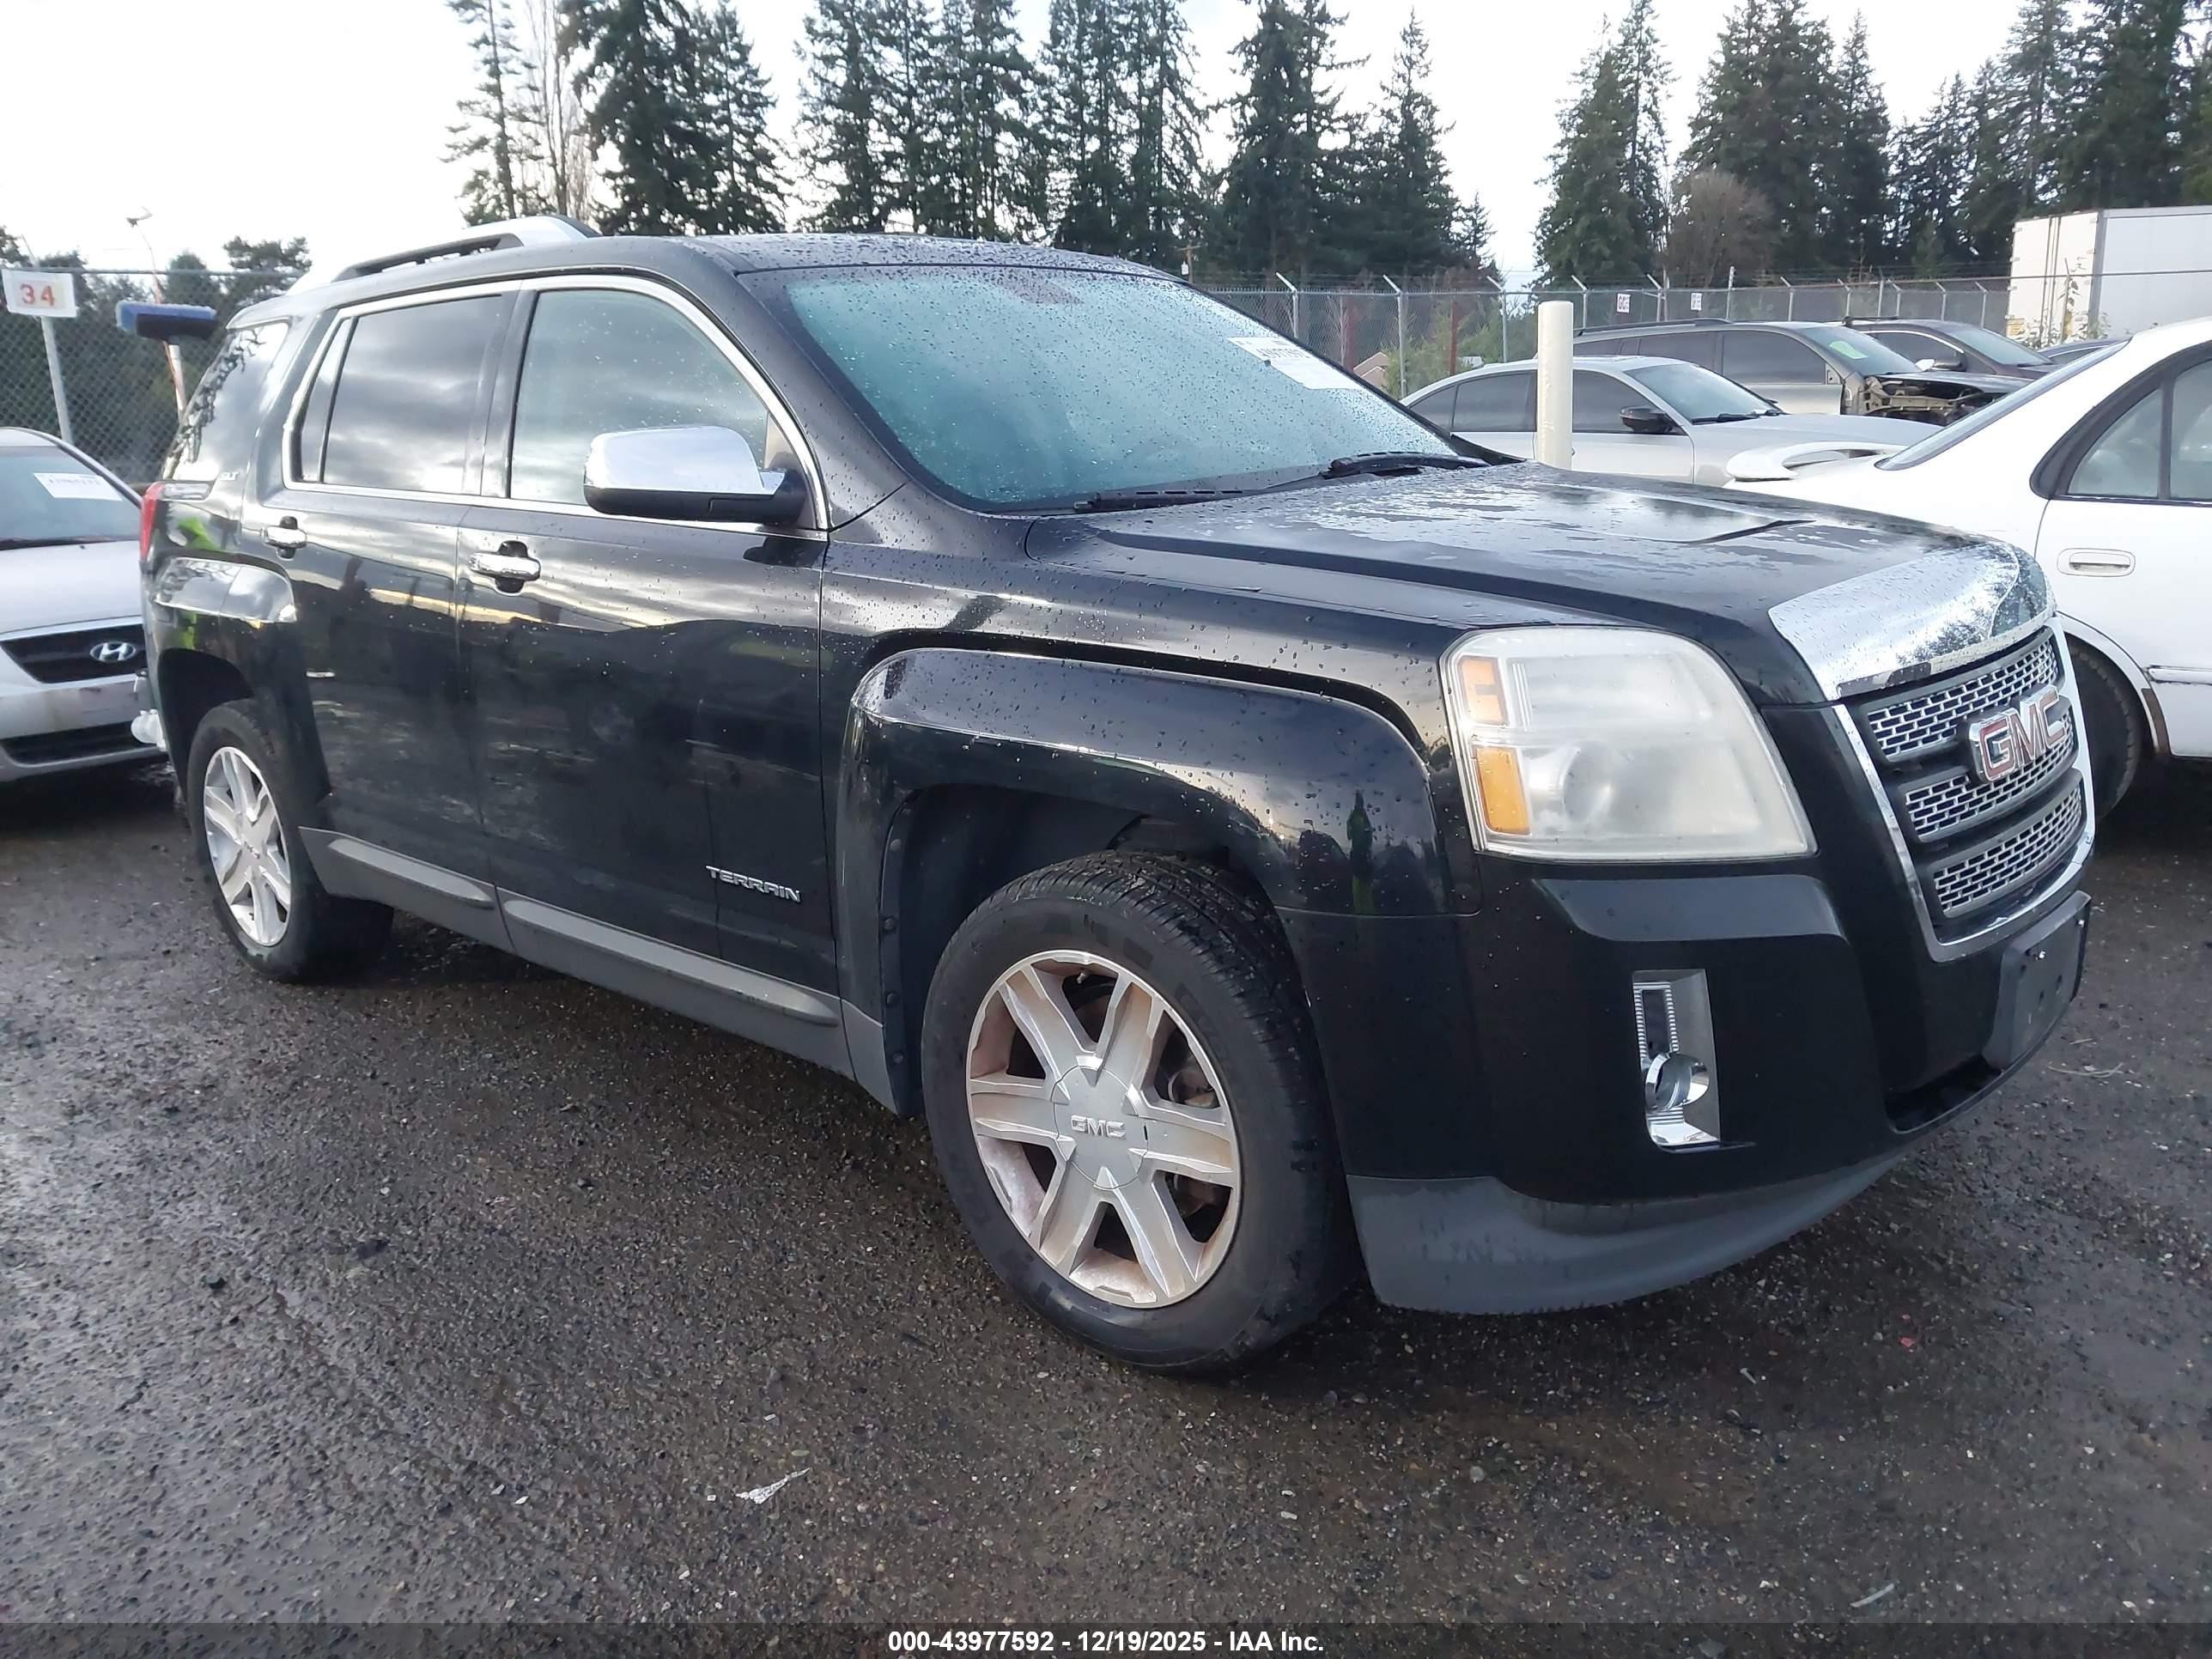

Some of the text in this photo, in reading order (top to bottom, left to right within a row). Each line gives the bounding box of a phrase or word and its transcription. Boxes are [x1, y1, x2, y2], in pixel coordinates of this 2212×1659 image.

[20, 283, 56, 307] 34
[1970, 685, 2066, 781] GMC
[705, 865, 802, 903] TERRAIN
[1070, 1115, 1127, 1139] GMC
